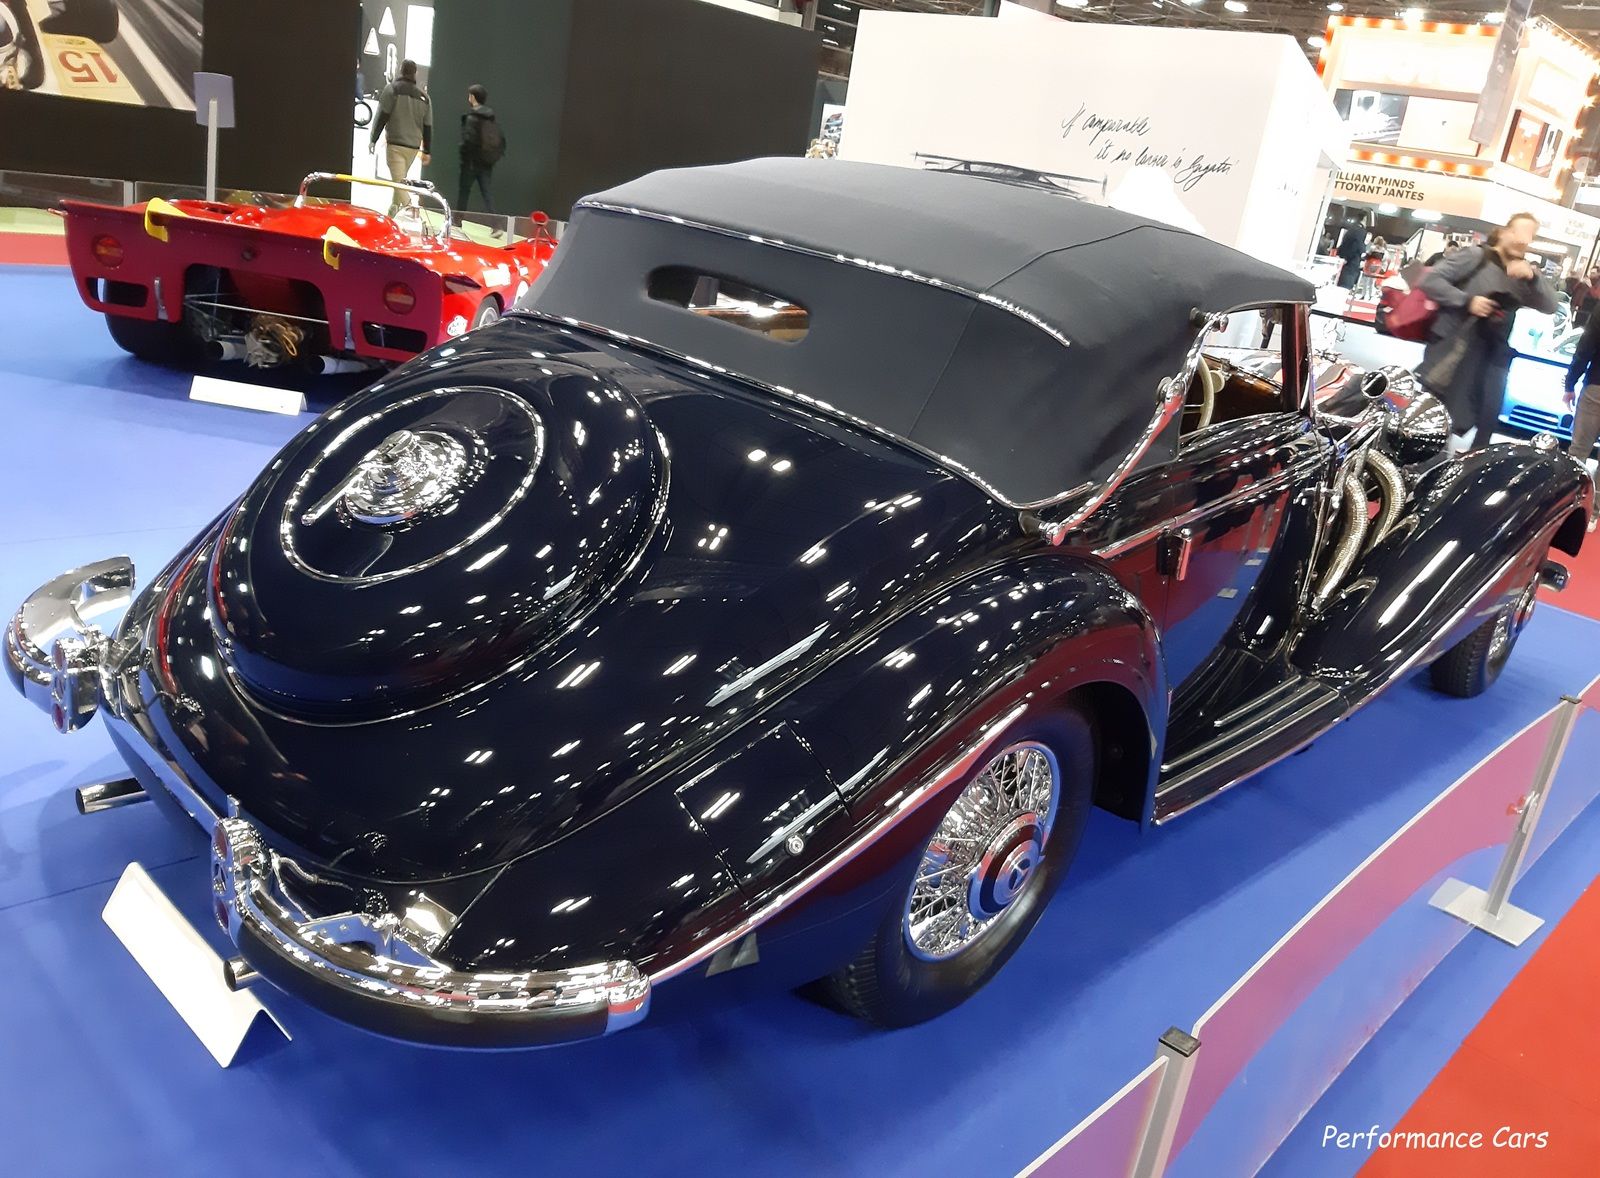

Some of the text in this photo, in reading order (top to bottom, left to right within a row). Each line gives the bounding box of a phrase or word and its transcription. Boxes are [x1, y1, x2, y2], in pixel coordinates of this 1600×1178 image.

[58, 50, 118, 83] 15
[1082, 113, 1151, 146] comparable
[1329, 170, 1415, 190] ILLIANT MINDS
[1383, 187, 1425, 201] JANTES
